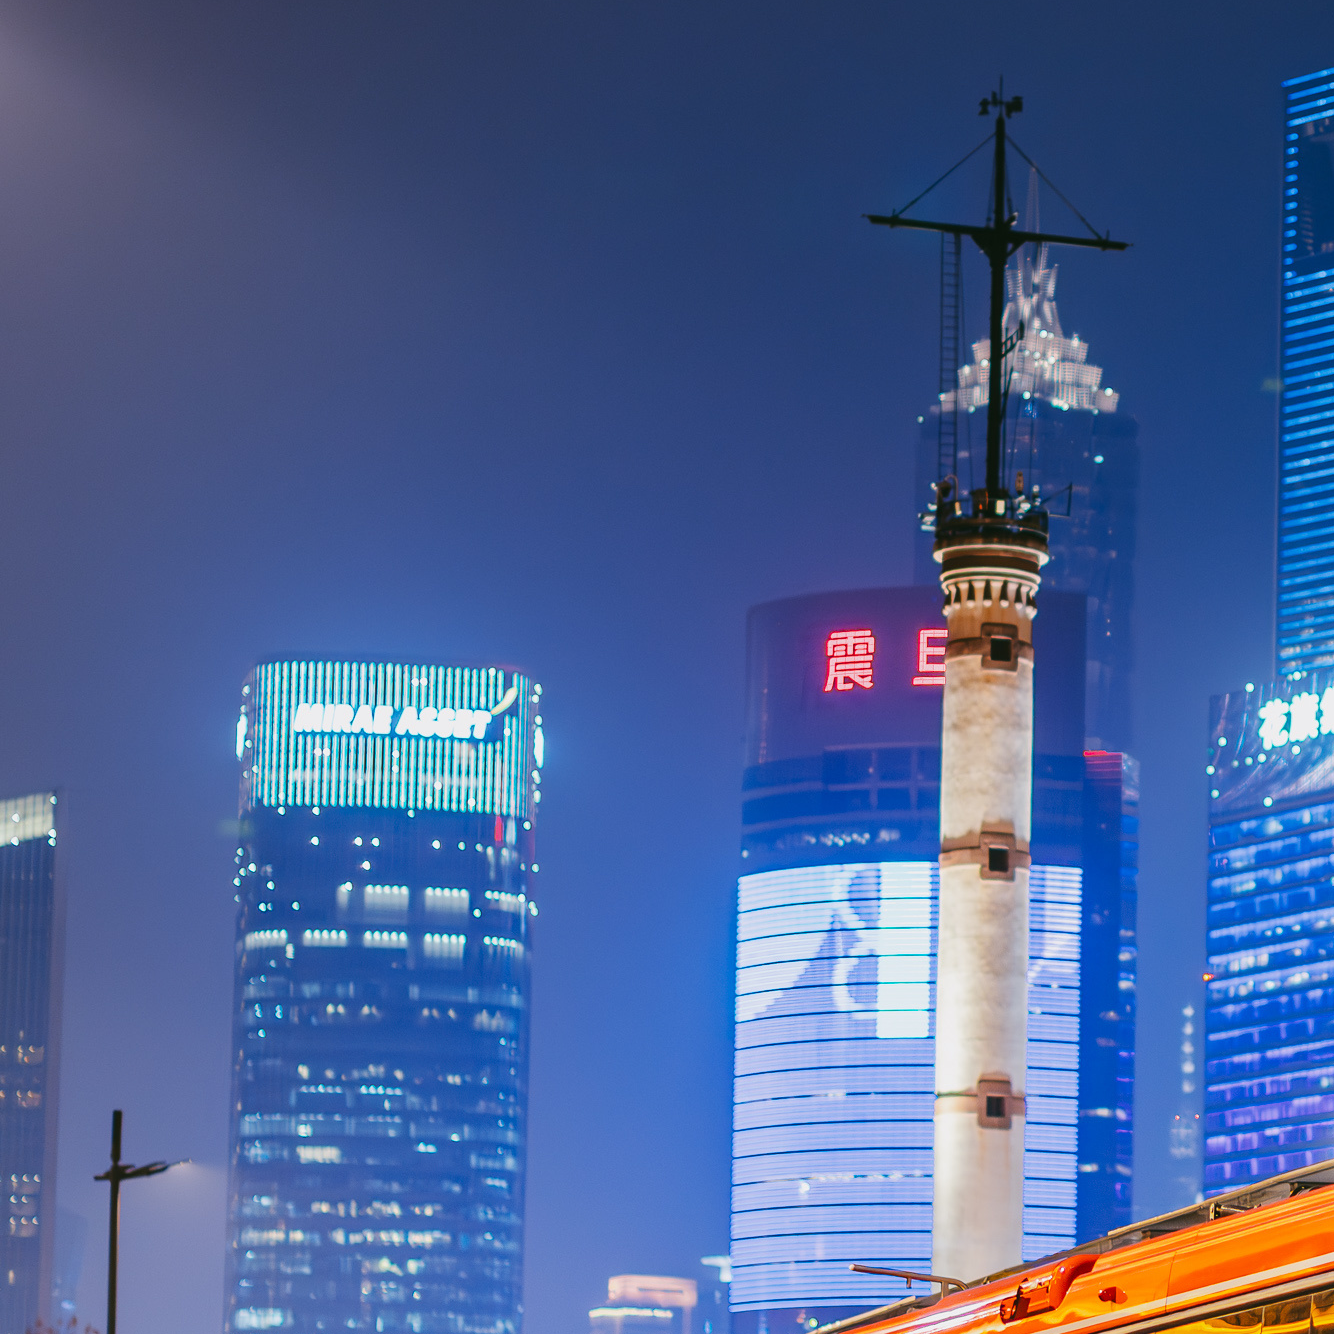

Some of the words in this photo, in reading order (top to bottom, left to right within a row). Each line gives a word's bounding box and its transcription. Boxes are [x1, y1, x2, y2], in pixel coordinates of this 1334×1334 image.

[824, 628, 948, 693] 震旦
[294, 702, 394, 734] MIRAE
[395, 706, 492, 740] ASSET
